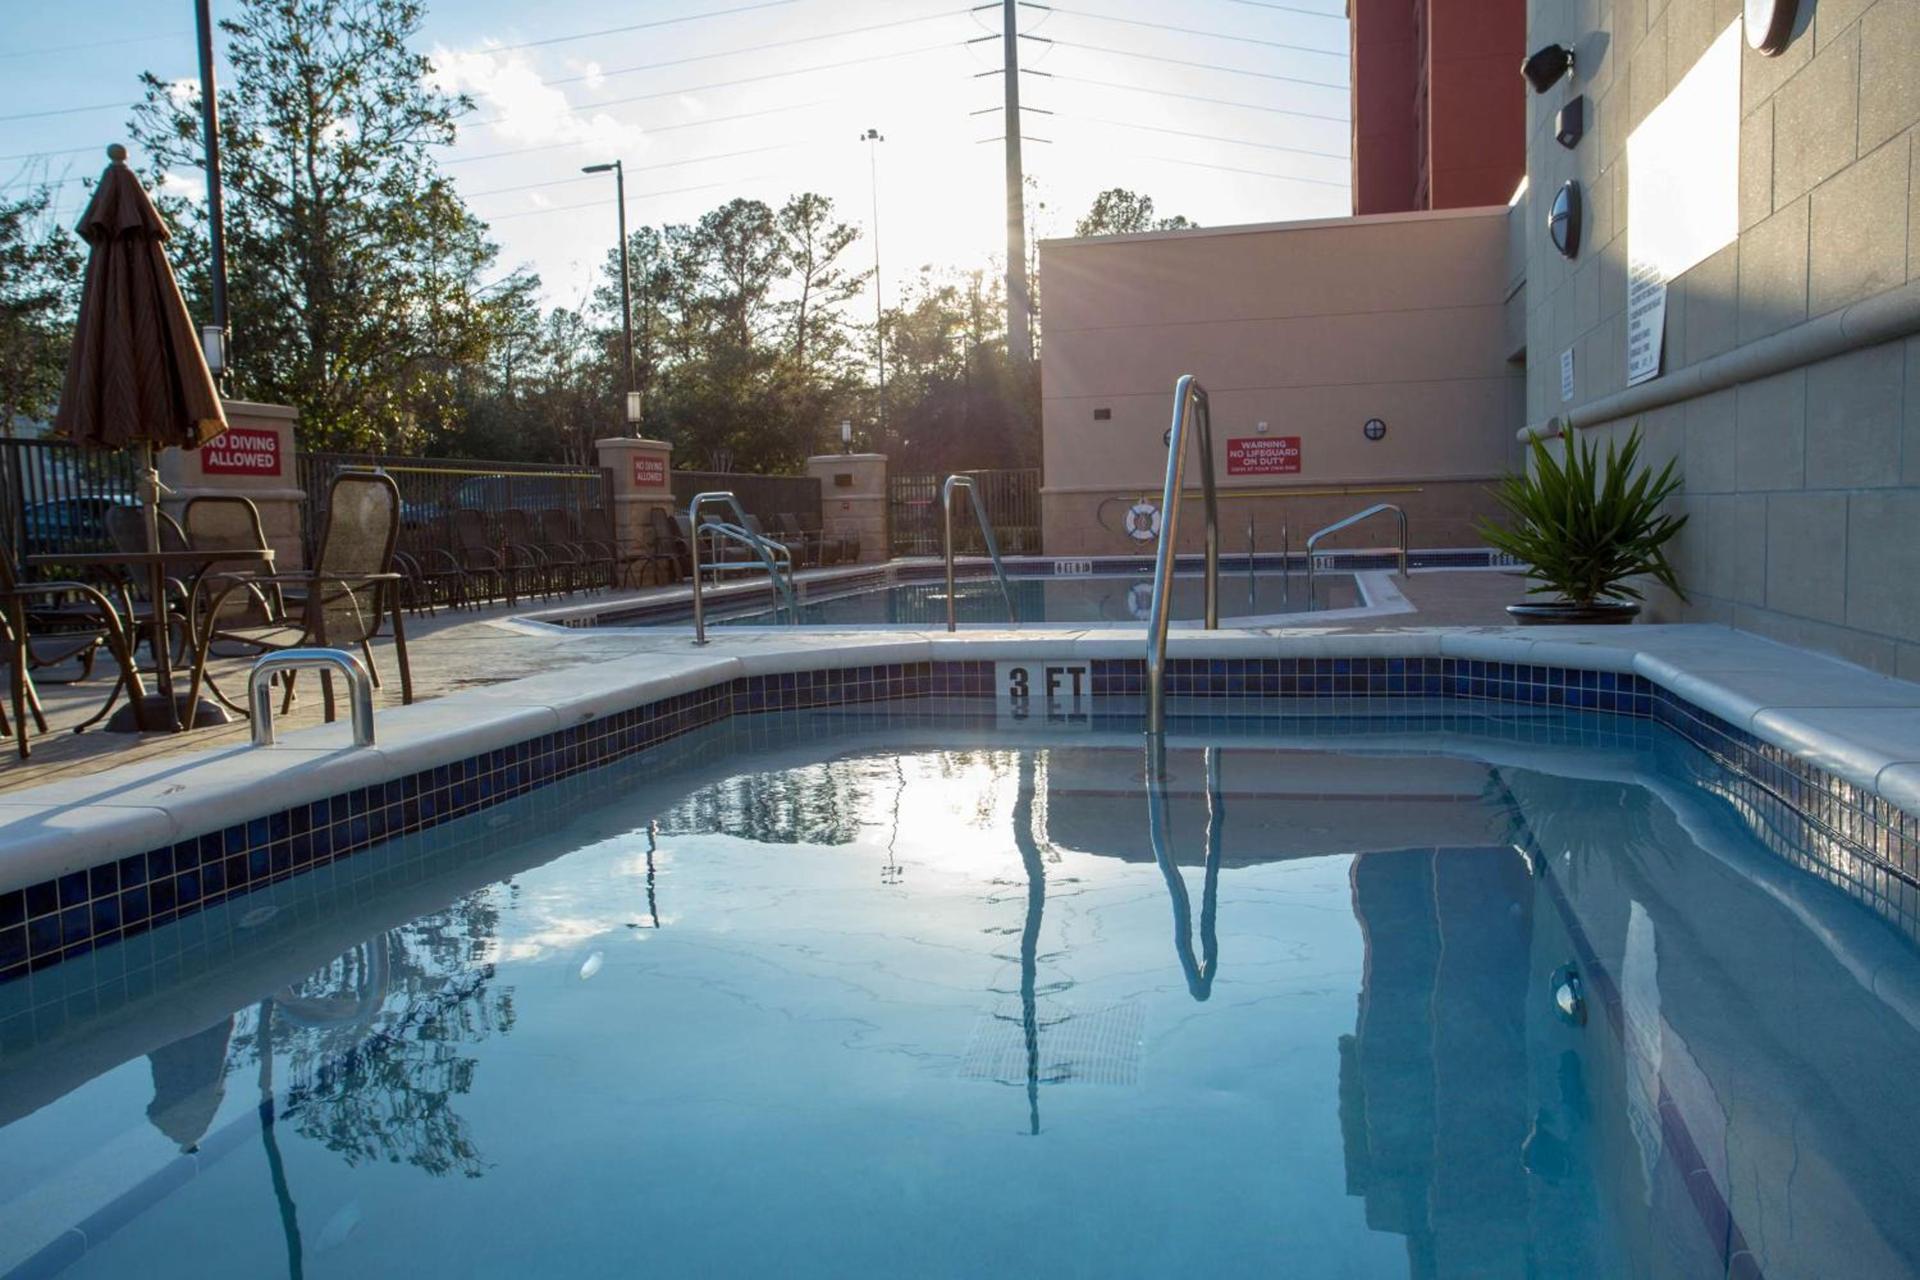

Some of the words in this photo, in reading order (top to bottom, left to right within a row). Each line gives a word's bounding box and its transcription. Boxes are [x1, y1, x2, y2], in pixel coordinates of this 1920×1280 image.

[205, 434, 226, 448] NO
[230, 435, 276, 452] DIVING
[1241, 440, 1287, 449] WARNING
[208, 450, 274, 468] ALLOWED
[1230, 449, 1244, 458] NO
[1246, 448, 1298, 458] LIFEGUARD
[1243, 458, 1257, 466] ON
[1260, 457, 1285, 465] DUTY
[1009, 668, 1029, 697] 3
[1046, 667, 1086, 697] FT
